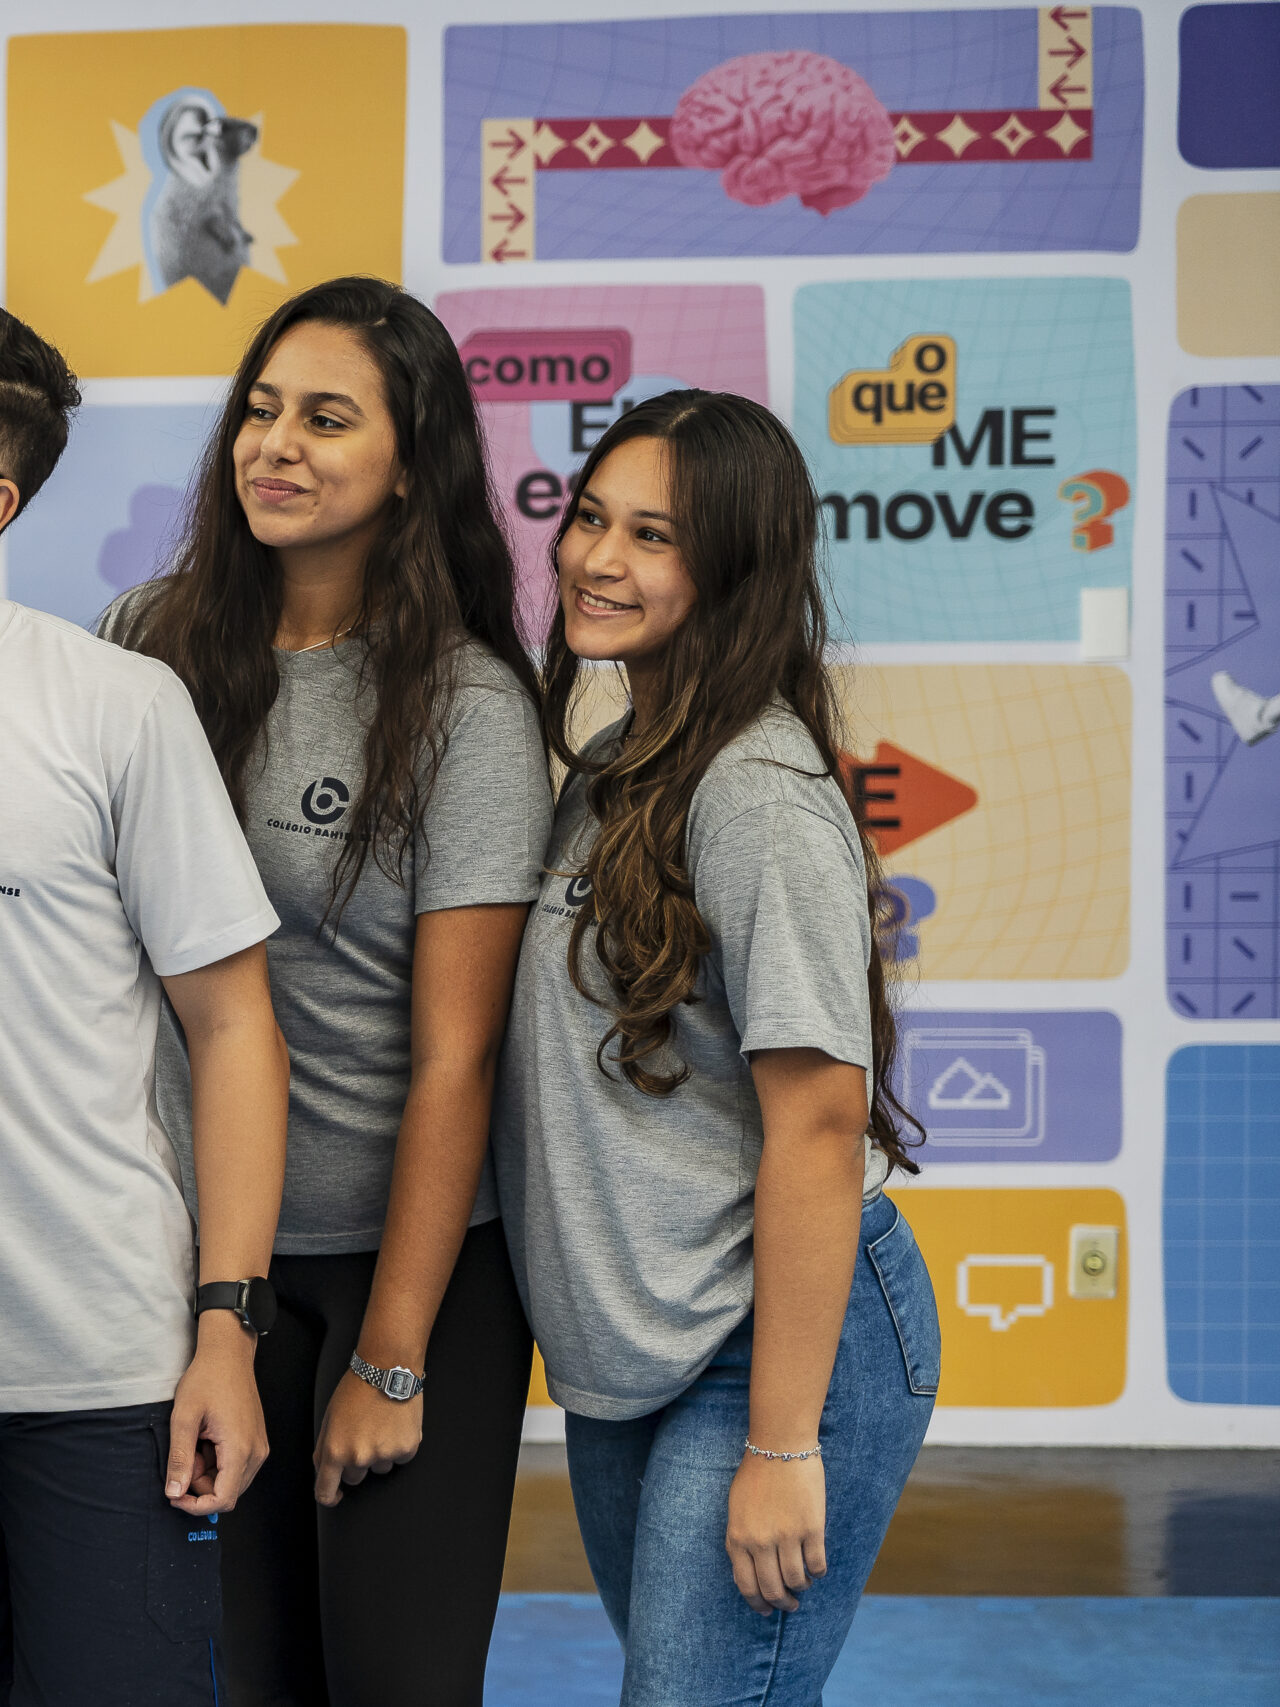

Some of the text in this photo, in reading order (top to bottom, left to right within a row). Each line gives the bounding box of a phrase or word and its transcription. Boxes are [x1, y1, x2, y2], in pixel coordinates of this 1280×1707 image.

[466, 354, 611, 385] como
[914, 341, 946, 375] o
[571, 400, 634, 453] E
[852, 380, 947, 424] que
[931, 407, 1056, 468] ME
[516, 469, 580, 520] e
[818, 490, 1034, 541] move
